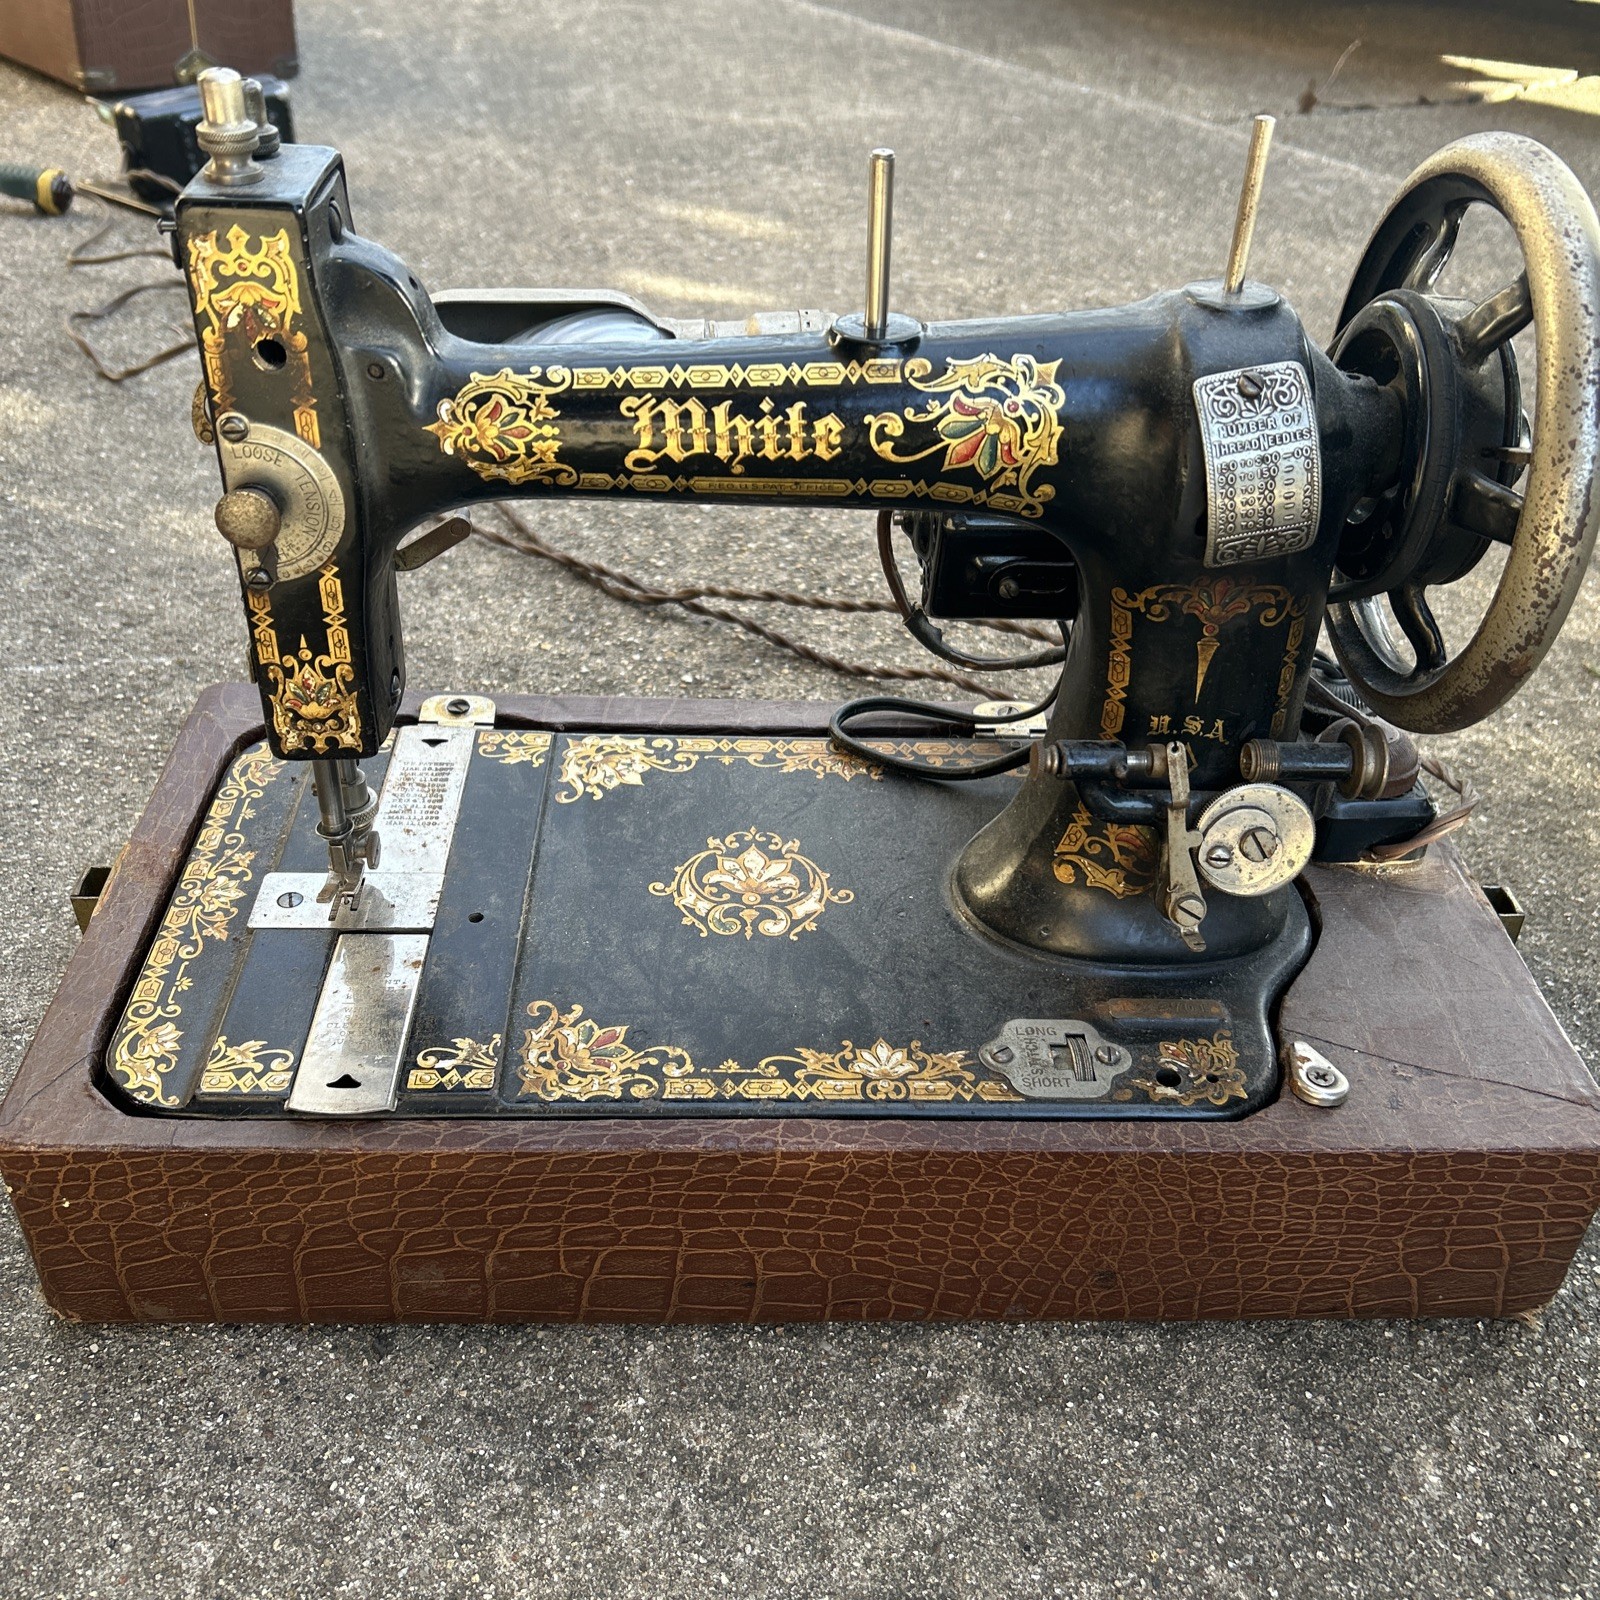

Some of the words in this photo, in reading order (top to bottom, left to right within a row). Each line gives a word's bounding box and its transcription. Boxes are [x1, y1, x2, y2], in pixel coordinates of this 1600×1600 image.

[619, 393, 846, 475] White
[1218, 416, 1277, 438] NUMBER
[1282, 413, 1302, 427] OF
[231, 445, 285, 467] LOOSE
[1217, 461, 1238, 474] 150
[1240, 459, 1253, 468] TO
[1294, 446, 1311, 459] 00
[1218, 473, 1236, 486] 90
[1240, 472, 1254, 481] TO
[1257, 466, 1279, 479] 150
[1219, 487, 1236, 499] 70
[1241, 485, 1255, 494] TO
[1258, 480, 1276, 492] 90
[295, 473, 321, 539] TENSION
[1218, 502, 1236, 513] 50
[1241, 497, 1255, 506] TO
[1258, 493, 1276, 505] 70
[1218, 513, 1236, 524] 30
[1241, 509, 1255, 518] TO
[1258, 506, 1276, 518] 50
[1218, 524, 1235, 535] 20
[1241, 521, 1255, 529] TO
[1257, 517, 1275, 529] 30
[1015, 1026, 1057, 1036] LONG
[1024, 1036, 1044, 1076] STITCH
[1022, 1077, 1071, 1088] SHORT
